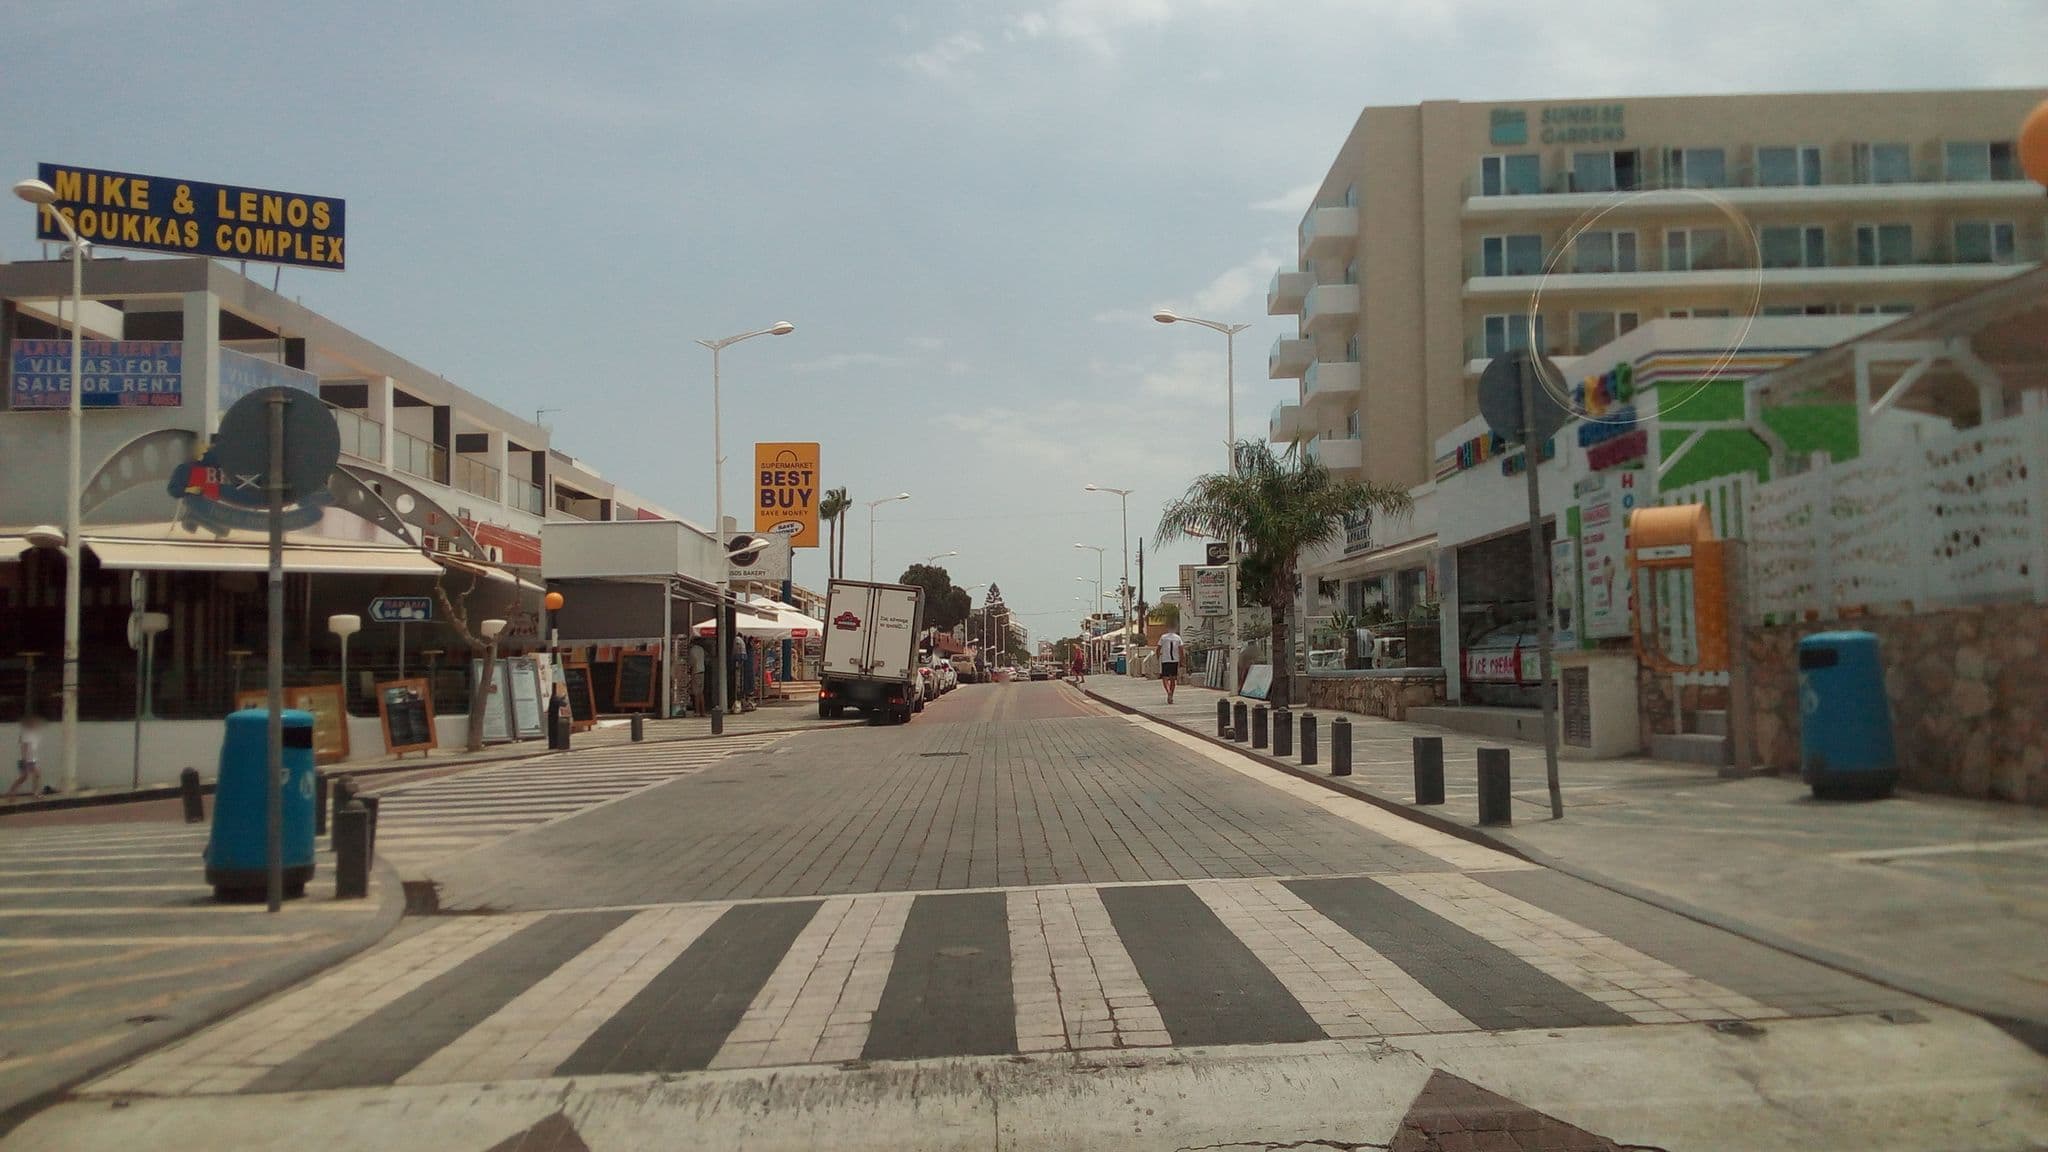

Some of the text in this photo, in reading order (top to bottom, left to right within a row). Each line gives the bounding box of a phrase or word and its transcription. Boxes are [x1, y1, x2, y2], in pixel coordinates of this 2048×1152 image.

[55, 169, 331, 231] MIKE & LENOS
[215, 224, 344, 264] COMPLEX
[31, 358, 169, 375] VILAS FOR
[17, 377, 71, 392] SALE
[124, 377, 177, 392] RENT
[760, 470, 814, 487] BEST
[760, 488, 814, 509] BUY
